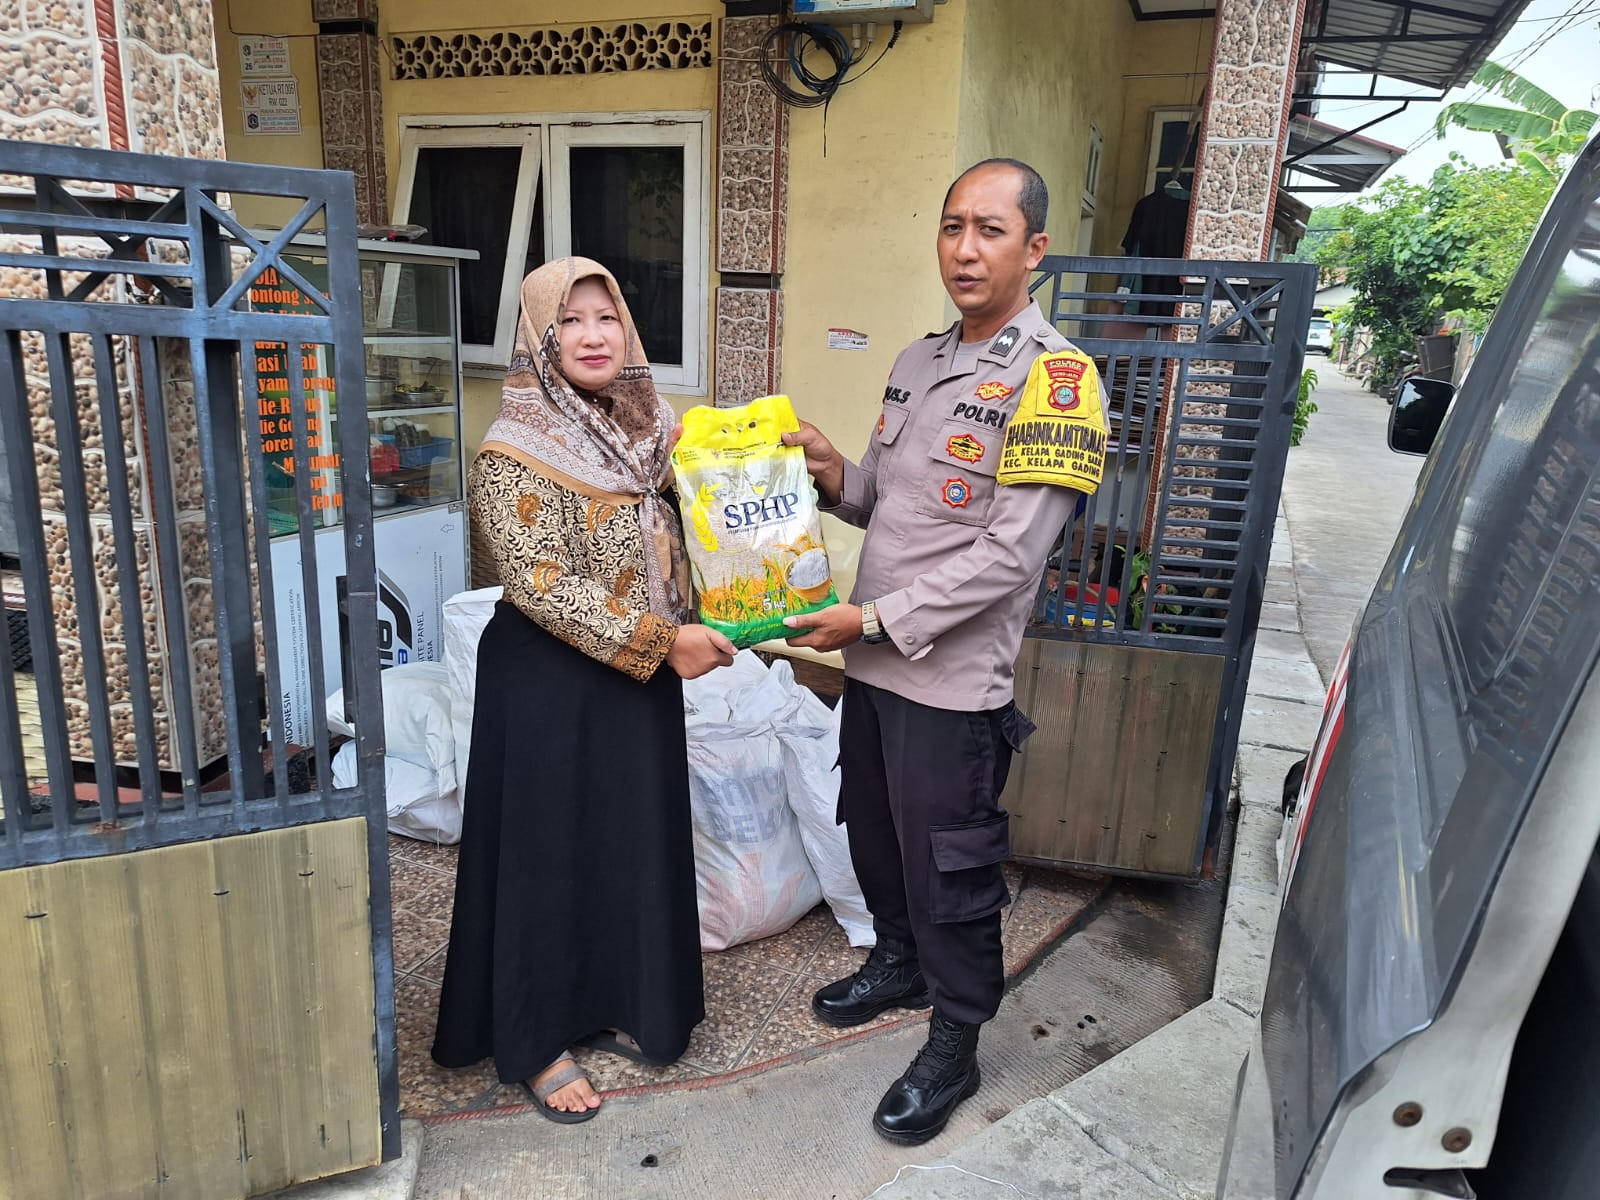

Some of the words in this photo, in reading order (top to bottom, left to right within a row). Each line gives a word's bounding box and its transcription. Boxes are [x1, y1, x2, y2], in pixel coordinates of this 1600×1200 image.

[258, 84, 277, 95] KETUA
[250, 288, 300, 306] ontong
[256, 377, 289, 394] yam
[953, 401, 1007, 429] POLRI
[1021, 446, 1050, 457] KELAPA
[1054, 448, 1085, 461] GADING
[1003, 458, 1021, 469] KEC.
[1027, 457, 1065, 469] KELAPA
[1071, 460, 1100, 478] GADING
[723, 492, 799, 529] SPHP
[763, 597, 773, 611] 5
